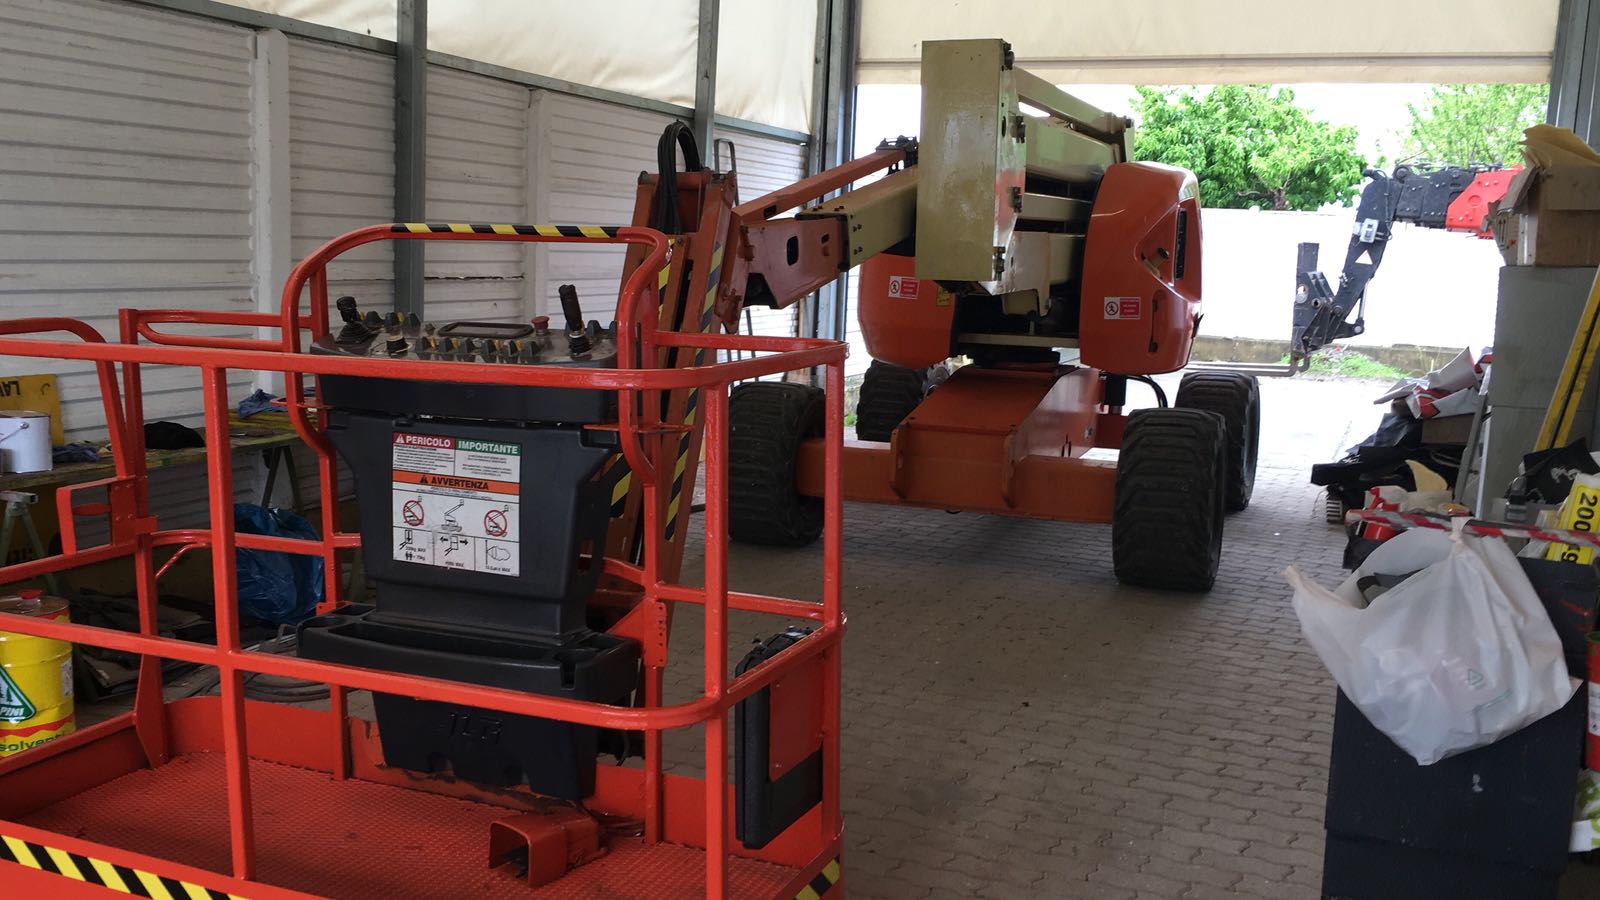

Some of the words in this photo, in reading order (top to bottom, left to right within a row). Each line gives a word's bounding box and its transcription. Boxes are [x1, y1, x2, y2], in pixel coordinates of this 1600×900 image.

[406, 436, 451, 447] PERICOLO
[458, 441, 519, 454] IMPORTANTE
[431, 476, 489, 490] AVVERTENZA
[1574, 492, 1598, 531] 200
